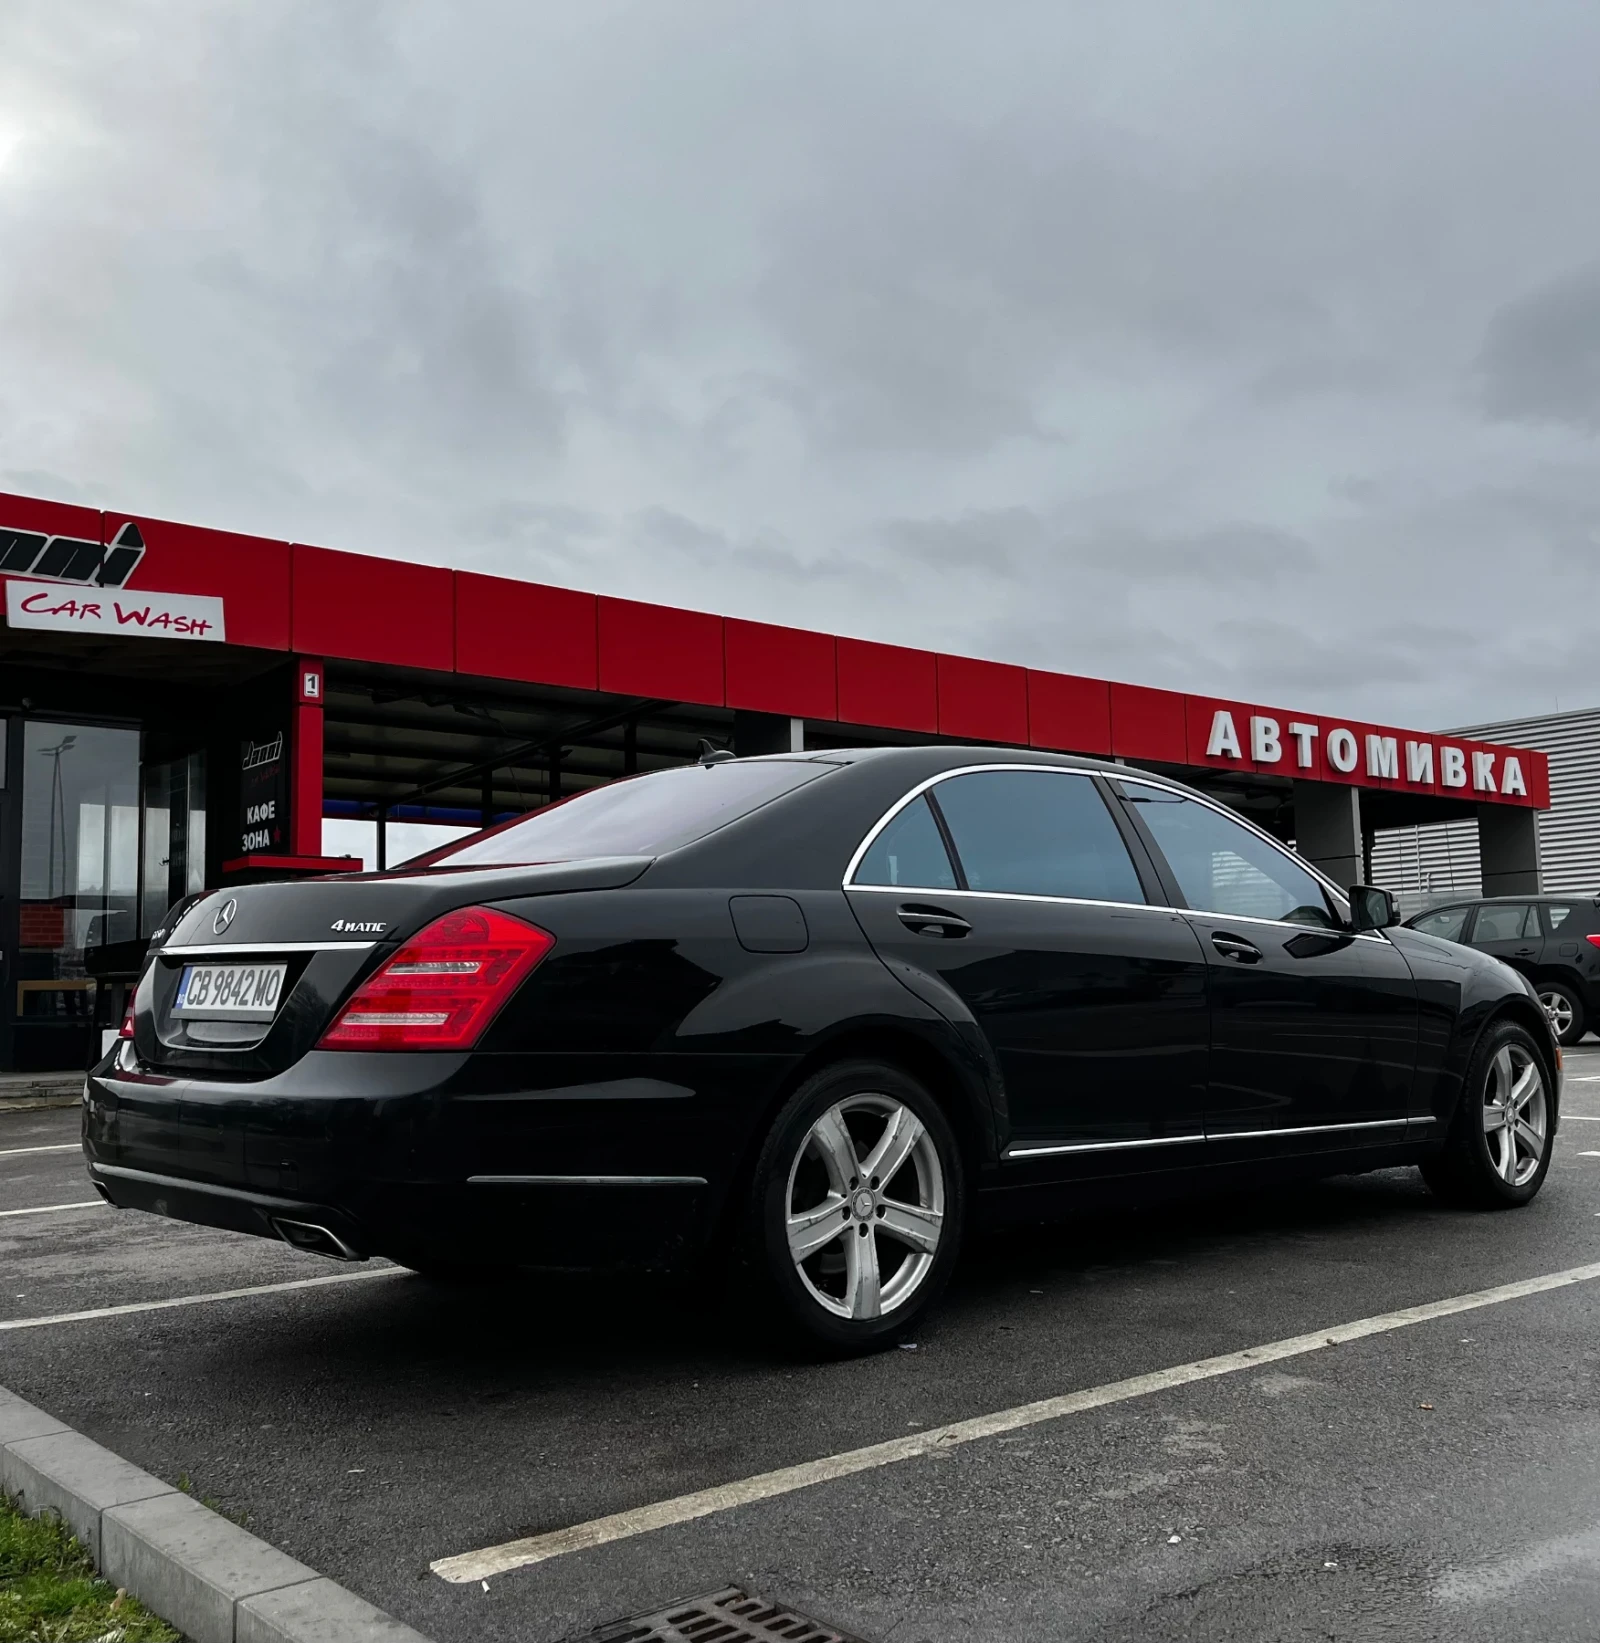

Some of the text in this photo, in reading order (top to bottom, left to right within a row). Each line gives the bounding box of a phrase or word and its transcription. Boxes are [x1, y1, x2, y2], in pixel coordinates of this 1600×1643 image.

[307, 675, 316, 690] 1
[1206, 710, 1528, 797] АВТОМИВКА
[246, 800, 275, 825] КАФЕ
[241, 829, 270, 852] ЗОНА
[331, 919, 387, 932] 4MATIC
[186, 969, 281, 1007] CB 9842 MO
